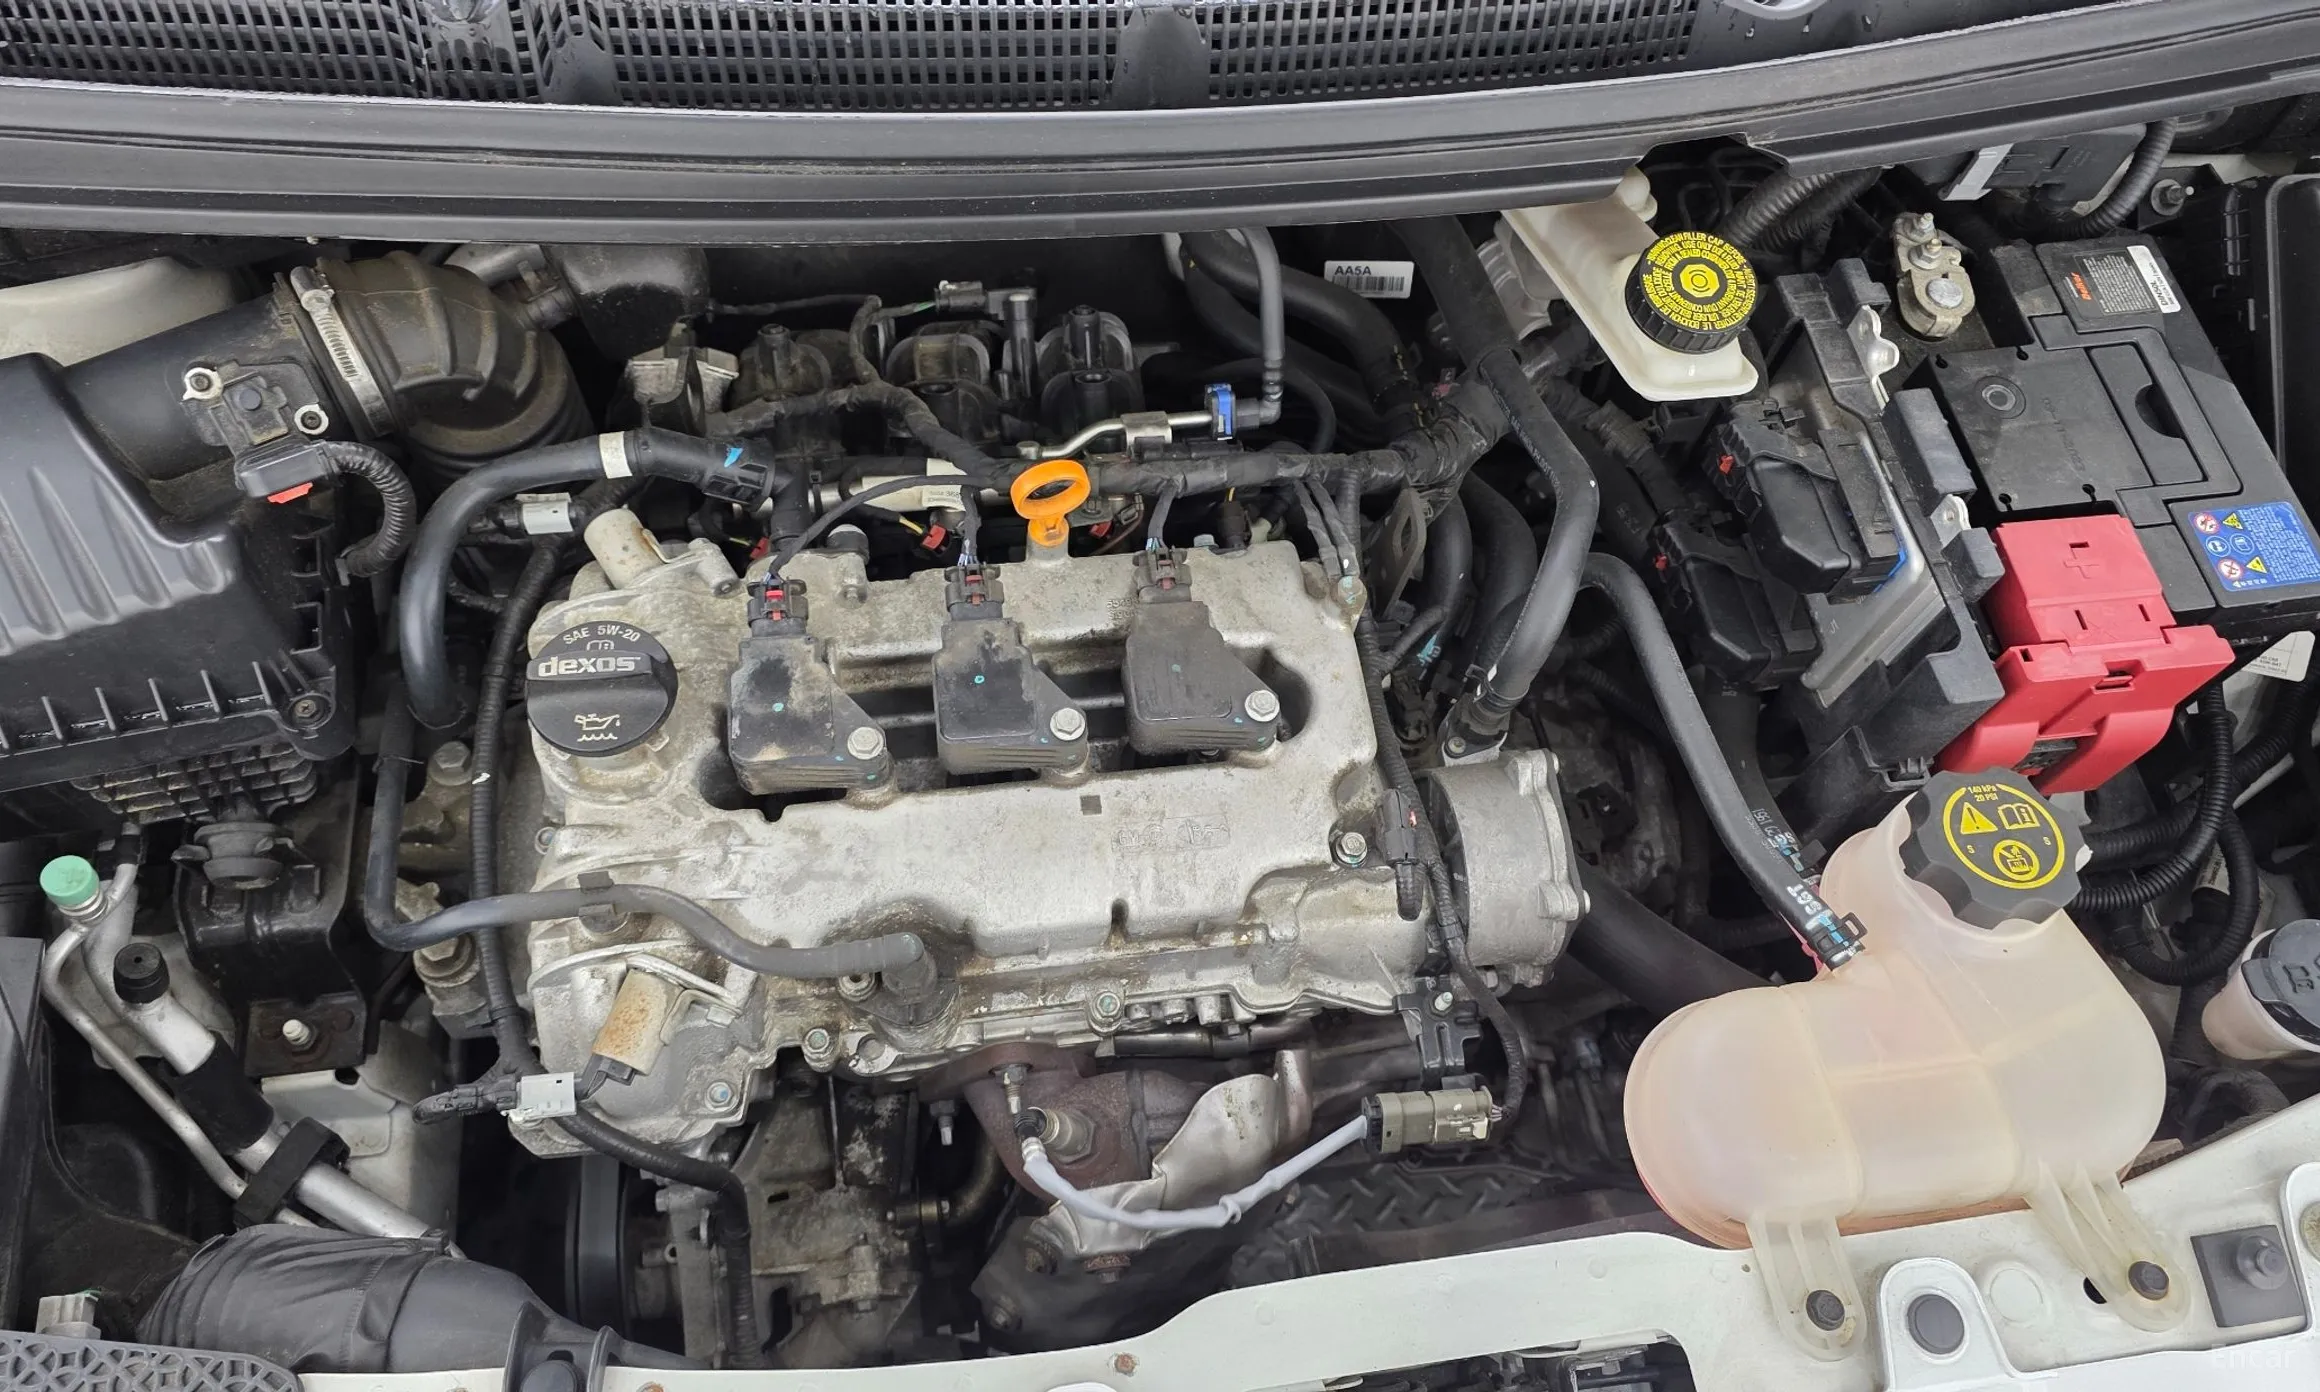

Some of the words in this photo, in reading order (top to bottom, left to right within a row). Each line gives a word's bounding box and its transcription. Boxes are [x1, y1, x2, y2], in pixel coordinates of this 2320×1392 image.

[1681, 240, 1696, 249] USE
[1683, 232, 1706, 241] FILLER
[1707, 235, 1724, 246] CAP
[1722, 242, 1746, 264] BEFORE
[1334, 265, 1372, 276] AA5A
[1658, 305, 1670, 315] DE
[1668, 312, 1698, 329] BOUCHON
[563, 627, 591, 645] SAE
[597, 624, 641, 642] 5W-20
[538, 656, 641, 677] dexos
[1968, 786, 1982, 794] 140
[1983, 784, 1998, 792] kPa
[1974, 794, 1985, 802] 20
[1986, 792, 1999, 801] PSI
